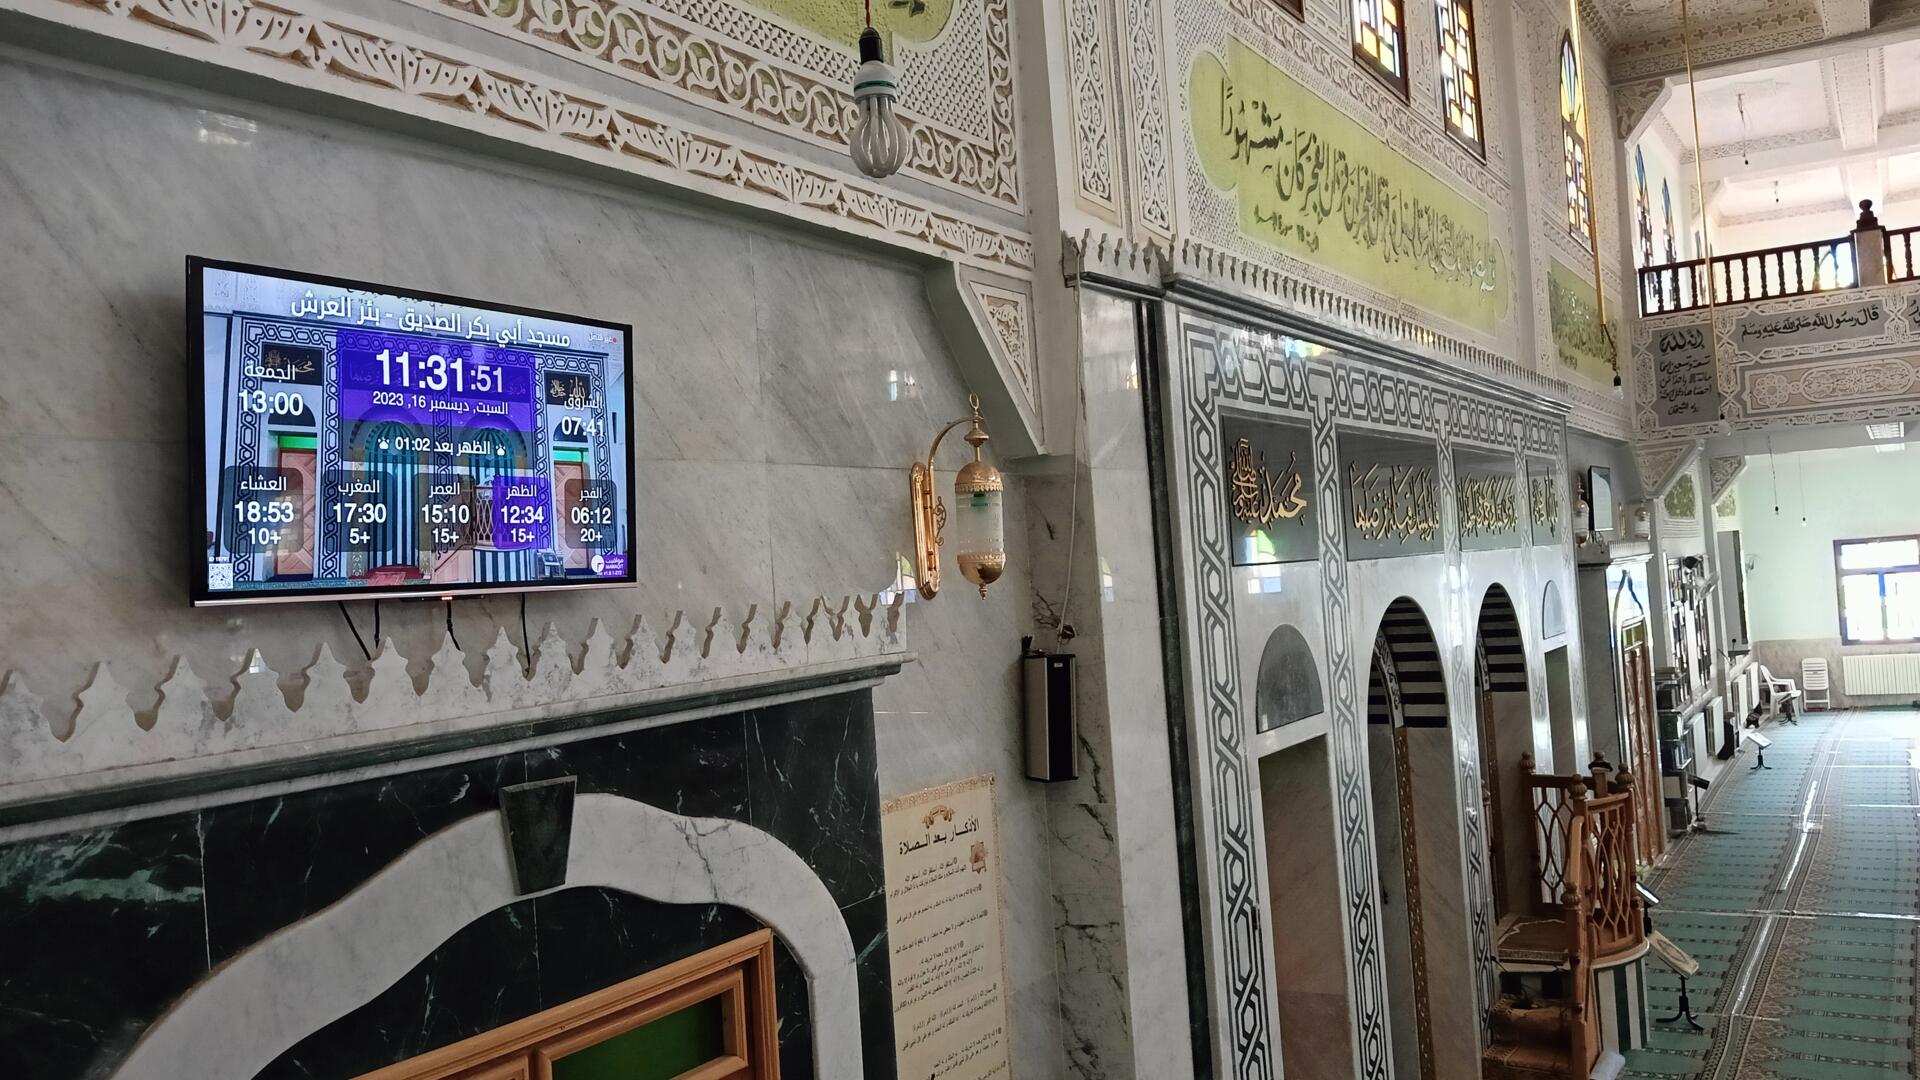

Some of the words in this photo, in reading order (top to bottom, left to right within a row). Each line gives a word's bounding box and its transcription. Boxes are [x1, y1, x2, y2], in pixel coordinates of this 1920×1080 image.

[291, 289, 352, 319] العرش
[357, 299, 380, 326] بئر
[398, 307, 461, 332] الصديق
[465, 315, 490, 340] بكر
[495, 319, 523, 348] أبي
[526, 328, 571, 348] مسجد
[244, 360, 297, 383] الجمعة
[238, 390, 304, 417] 13:00
[372, 390, 404, 407] 2023
[428, 398, 470, 413] ديسمبر
[561, 416, 603, 437] 07:41
[395, 436, 431, 451] 01:02
[434, 443, 454, 455] بعد
[456, 440, 491, 457] الظهر
[240, 474, 287, 492] العشاء
[338, 478, 380, 497] المغرب
[428, 482, 461, 498] العصر
[506, 485, 537, 500] الظهر
[579, 488, 603, 502] الفجر
[234, 500, 294, 523] 18:53
[333, 502, 387, 524] 17:30
[421, 504, 470, 524] 15:10
[500, 505, 544, 525] 12:34
[571, 507, 612, 525] 06:12
[899, 832, 931, 856] الصلاة
[932, 832, 948, 845] بعد
